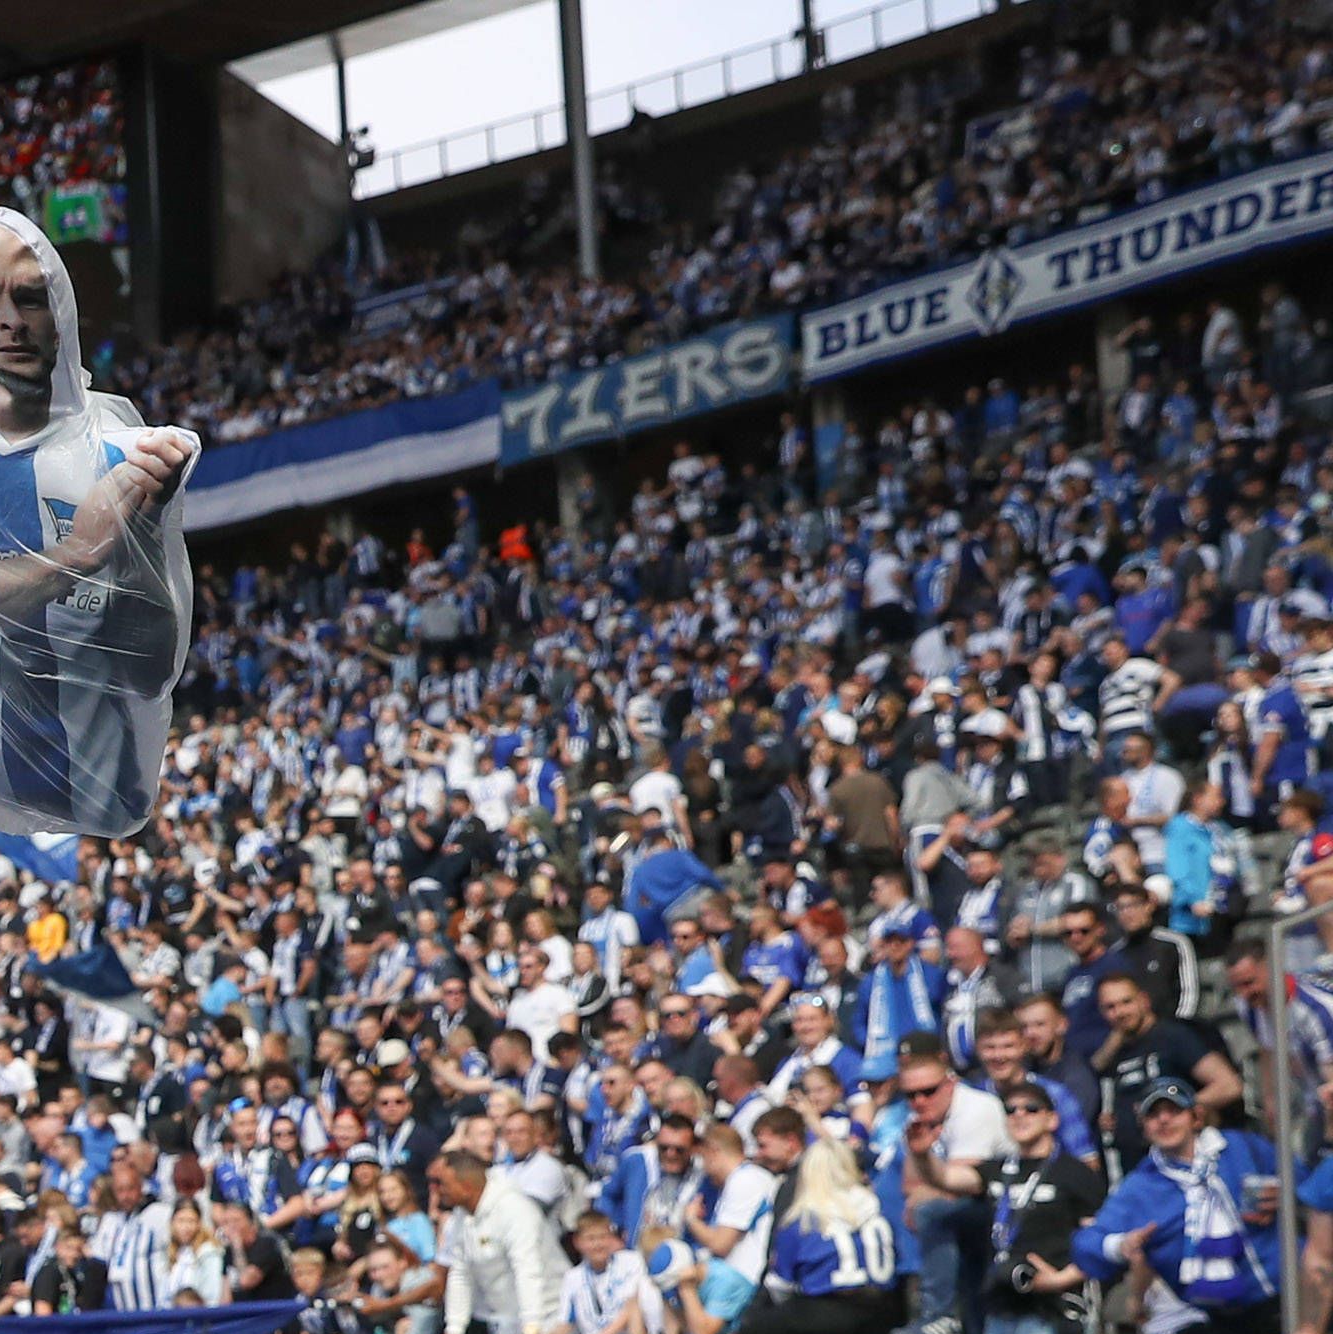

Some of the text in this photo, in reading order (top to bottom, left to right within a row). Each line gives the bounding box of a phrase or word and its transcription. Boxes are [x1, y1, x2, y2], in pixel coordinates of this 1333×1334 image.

[818, 287, 950, 359] BLUE
[502, 325, 793, 450] 71ERS
[830, 1216, 896, 1287] 10
